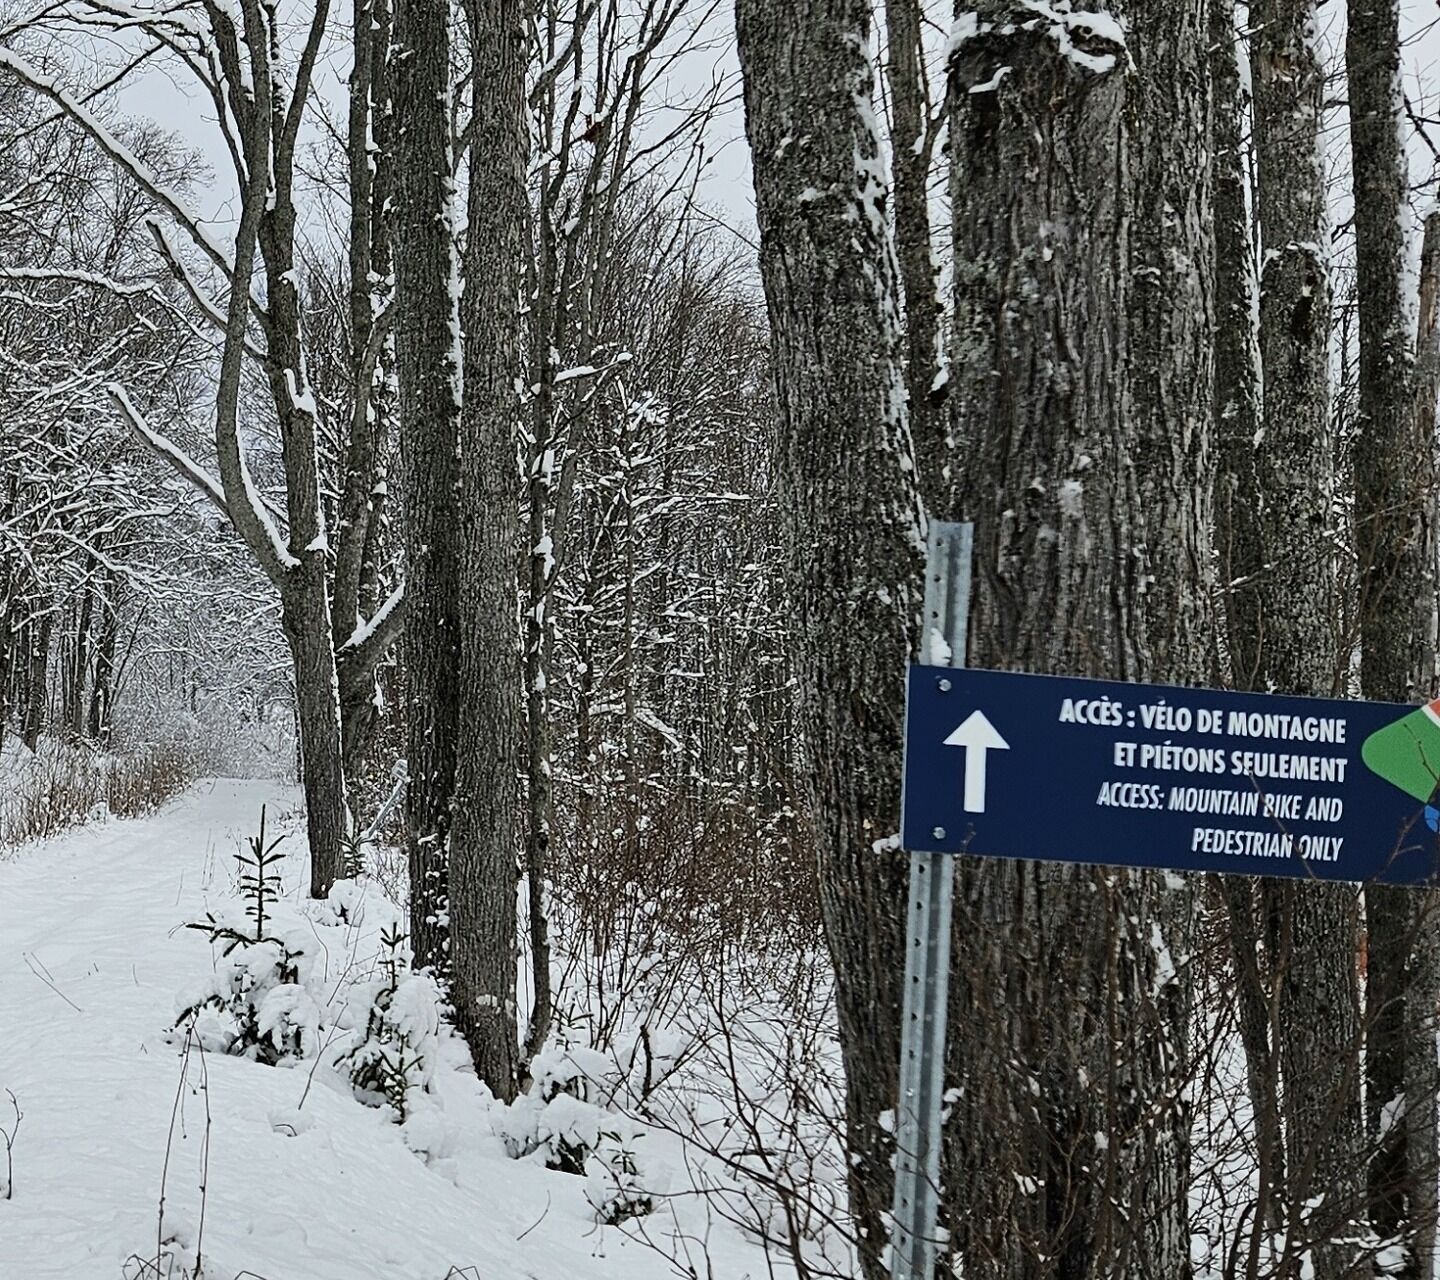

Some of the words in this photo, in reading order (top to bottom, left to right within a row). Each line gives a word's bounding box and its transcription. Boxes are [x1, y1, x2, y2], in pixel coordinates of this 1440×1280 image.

[1059, 695, 1123, 727] ACCÈS
[1139, 699, 1192, 732] VÉLO
[1197, 710, 1223, 734] DE
[1227, 711, 1347, 743] MONTAGNE
[1114, 742, 1136, 767] ET
[1140, 741, 1225, 775] PIÉTONS
[1230, 751, 1347, 783] SEULEMENT
[1096, 781, 1164, 810] ACCESS:
[1167, 787, 1260, 816] MOUNTAIN
[1263, 794, 1302, 820] BIKE
[1304, 796, 1343, 823] AND
[1191, 827, 1294, 858] PEDESTRIAN
[1298, 834, 1344, 861] ONLY
